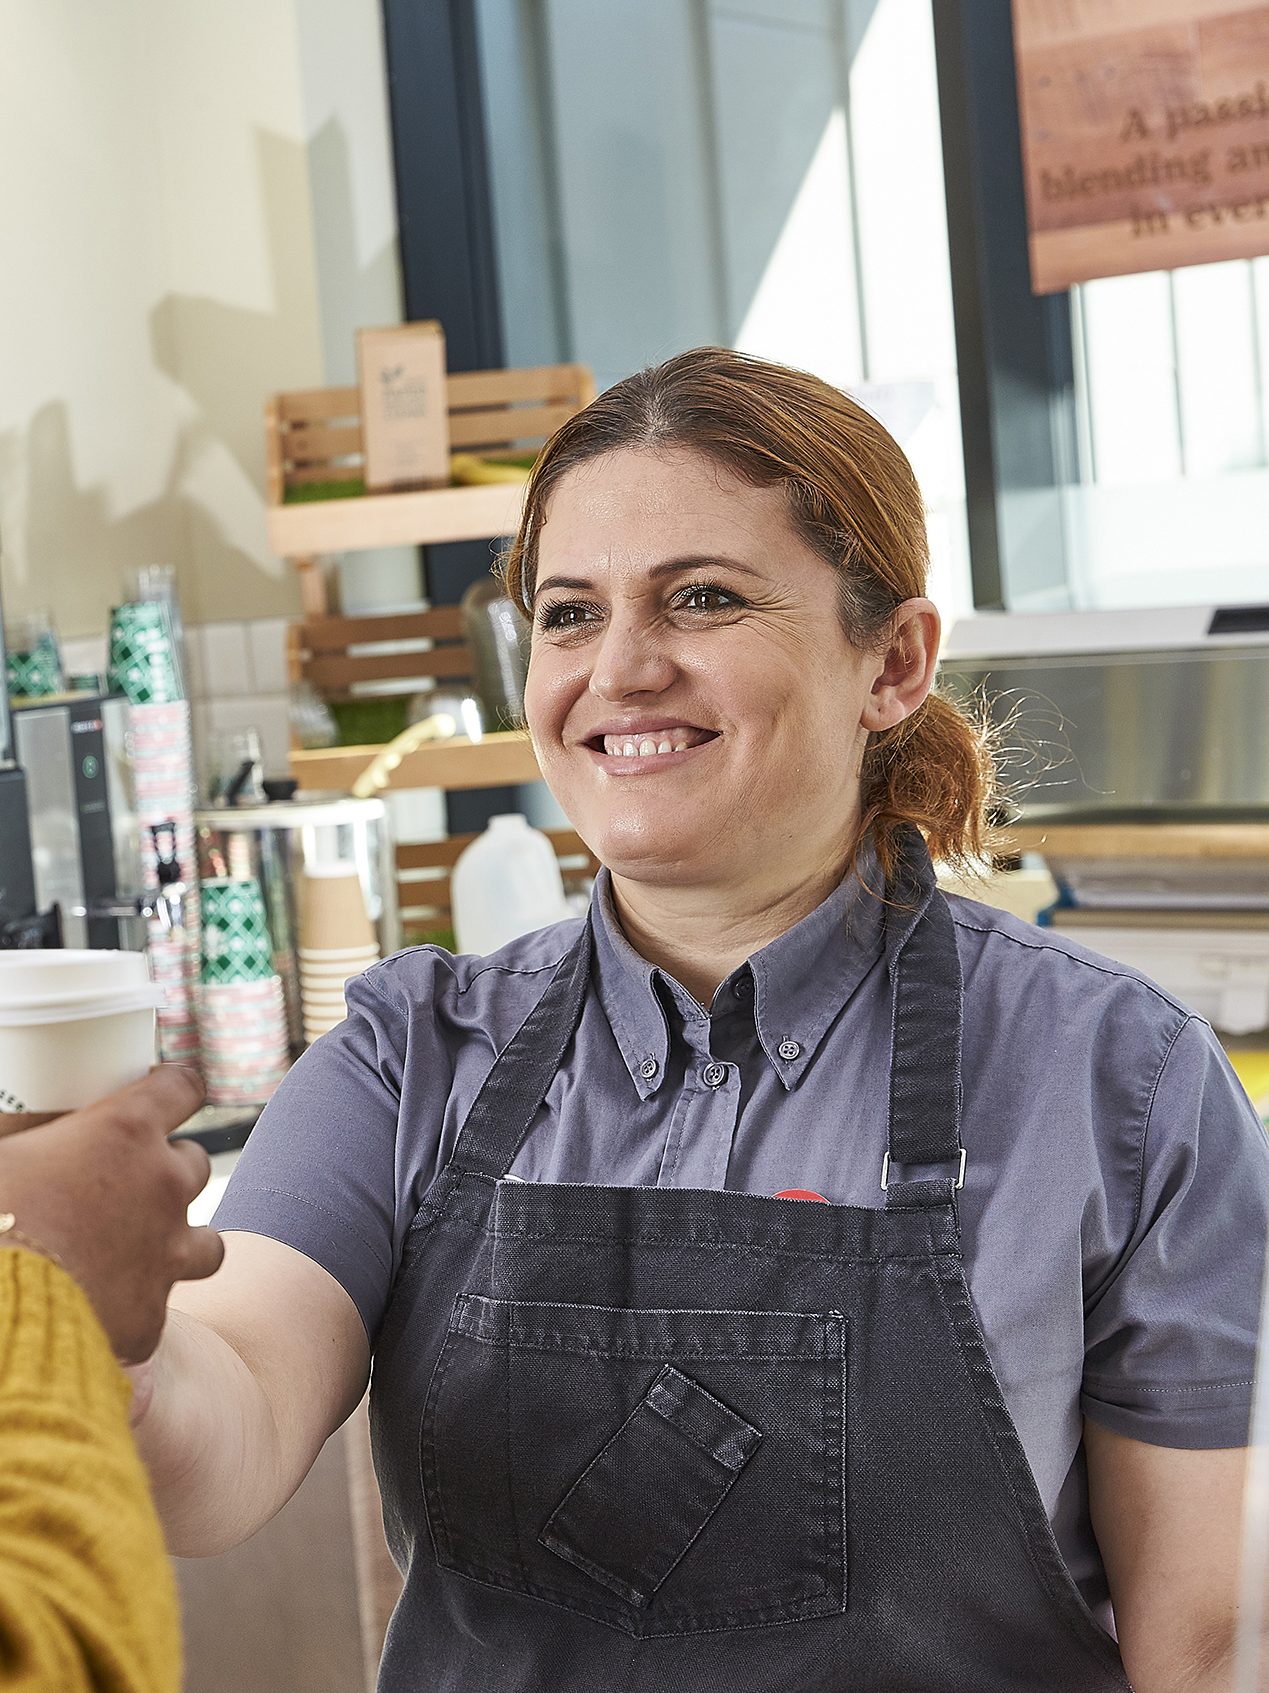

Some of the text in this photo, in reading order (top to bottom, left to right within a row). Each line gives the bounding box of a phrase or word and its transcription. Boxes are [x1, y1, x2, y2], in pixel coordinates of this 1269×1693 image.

[1120, 108, 1150, 145] A
[1039, 148, 1213, 203] blending
[1130, 201, 1171, 241] in
